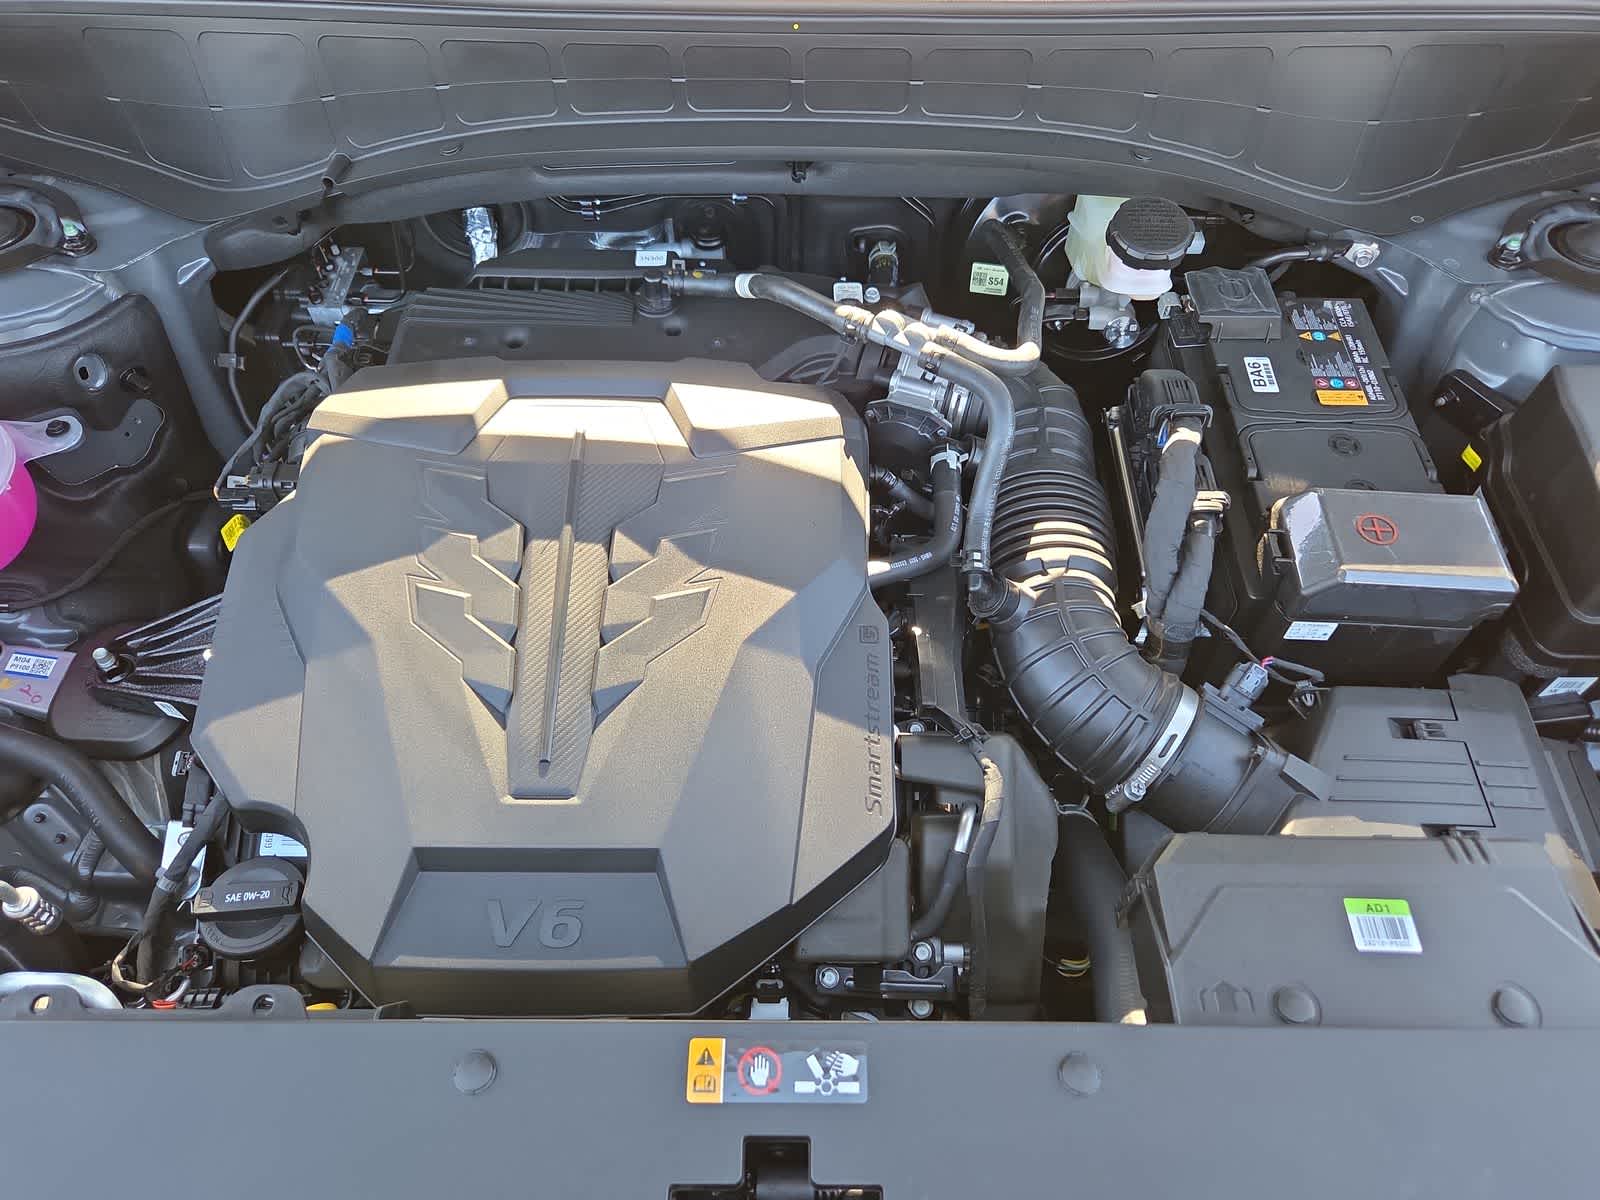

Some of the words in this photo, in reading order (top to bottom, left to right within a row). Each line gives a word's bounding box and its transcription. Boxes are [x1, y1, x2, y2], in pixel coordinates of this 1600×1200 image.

[988, 277, 1004, 286] S54
[1247, 362, 1267, 387] BA6
[13, 655, 31, 663] M04
[863, 653, 882, 817] Smartstream
[224, 892, 242, 904] SAE
[243, 889, 271, 902] 0W-20
[1366, 903, 1391, 913] AD1
[486, 898, 585, 950] V6
